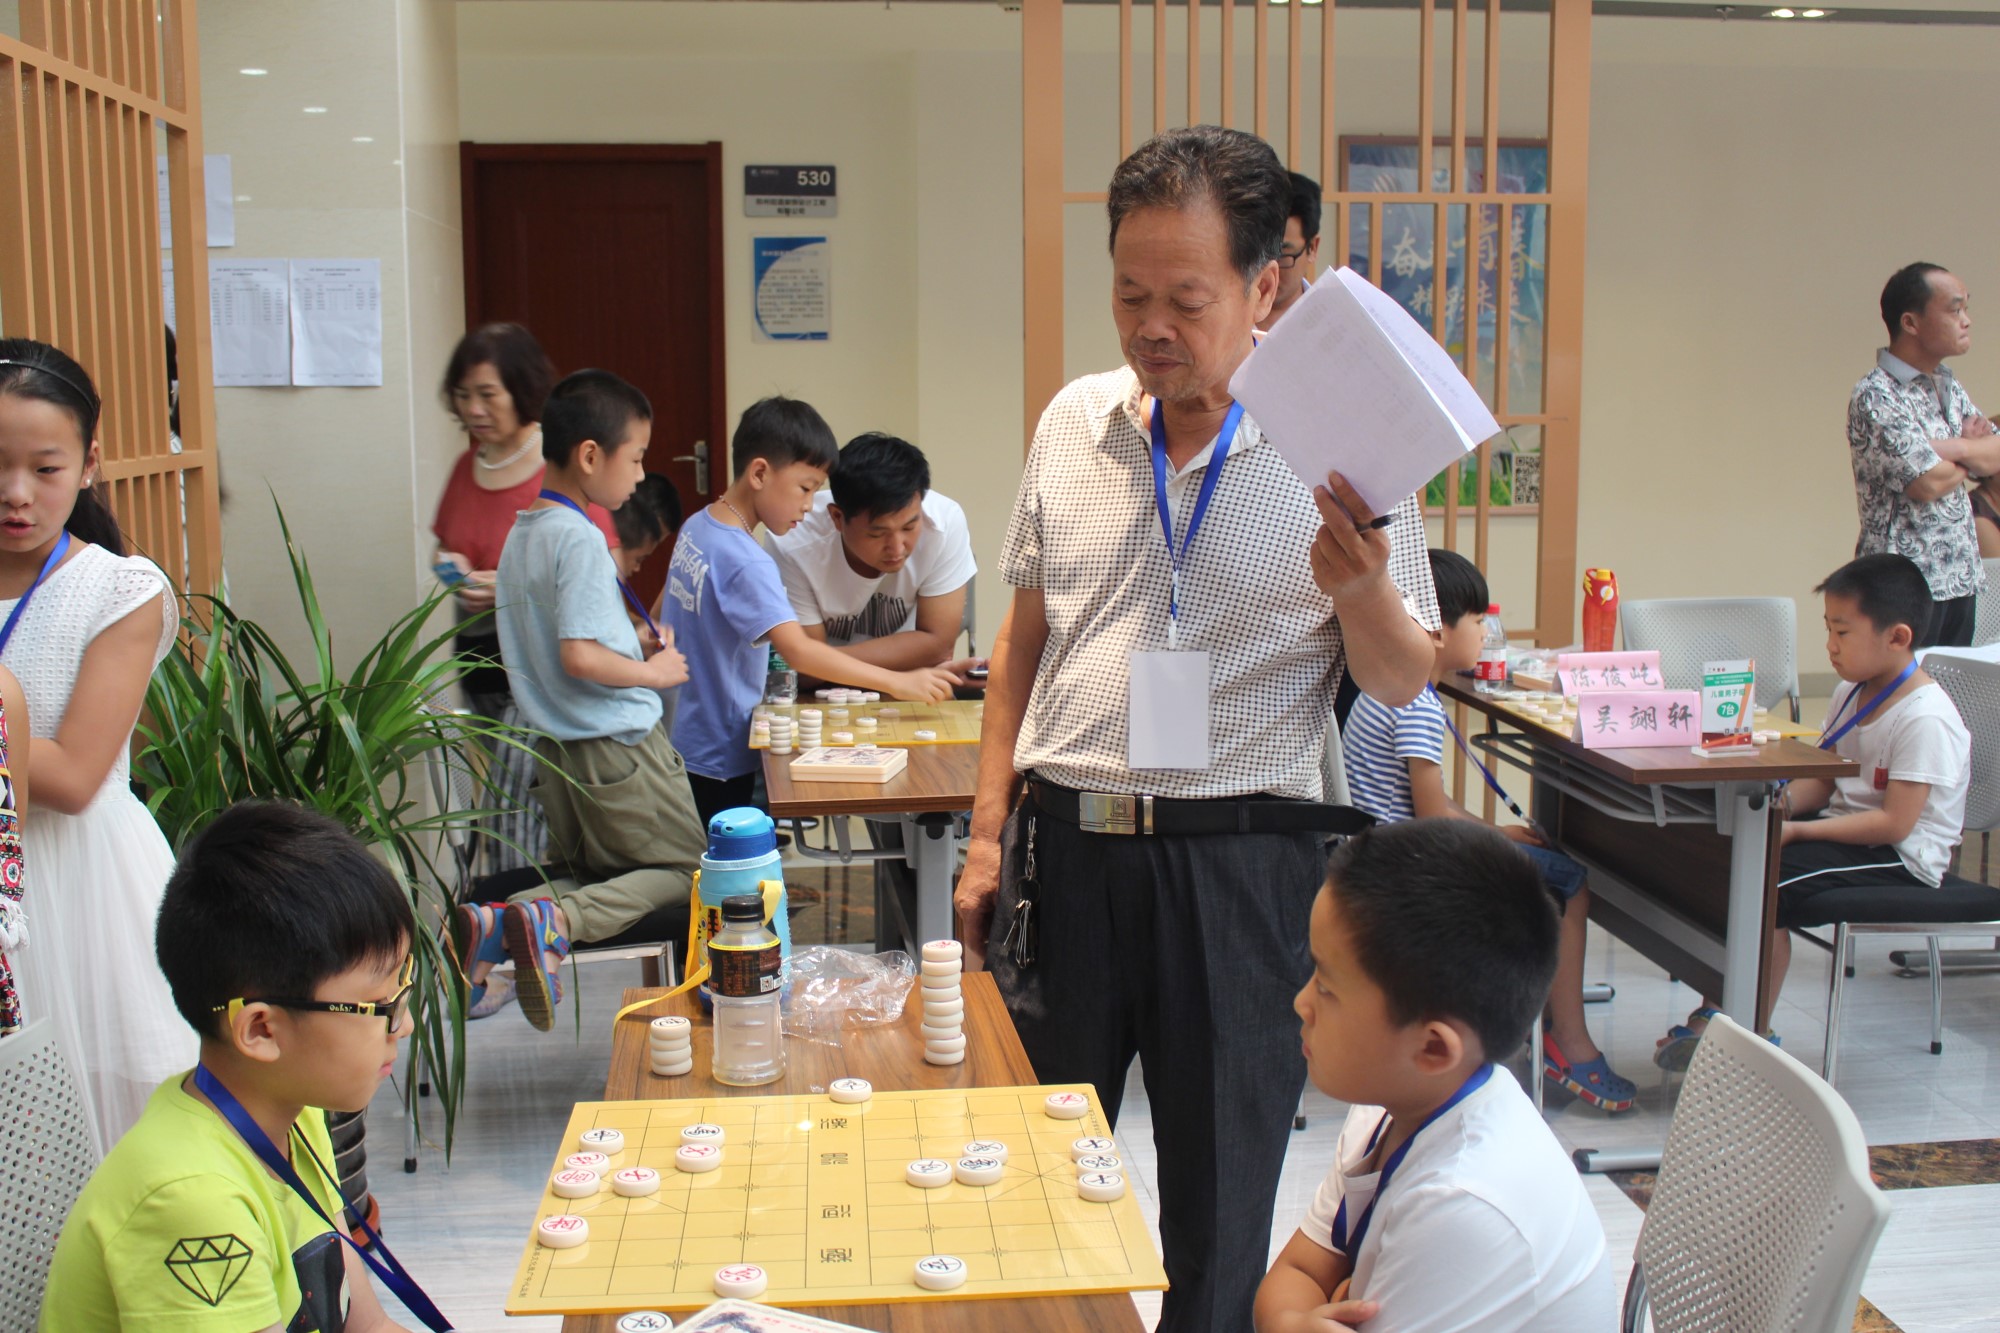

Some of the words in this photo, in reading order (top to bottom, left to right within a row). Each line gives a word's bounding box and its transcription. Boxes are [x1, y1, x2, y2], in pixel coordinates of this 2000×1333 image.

[797, 170, 831, 186] 530
[1570, 663, 1658, 688] 陈俊屹
[1593, 702, 1693, 733] 吴翊轩
[1721, 704, 1735, 716] 7台
